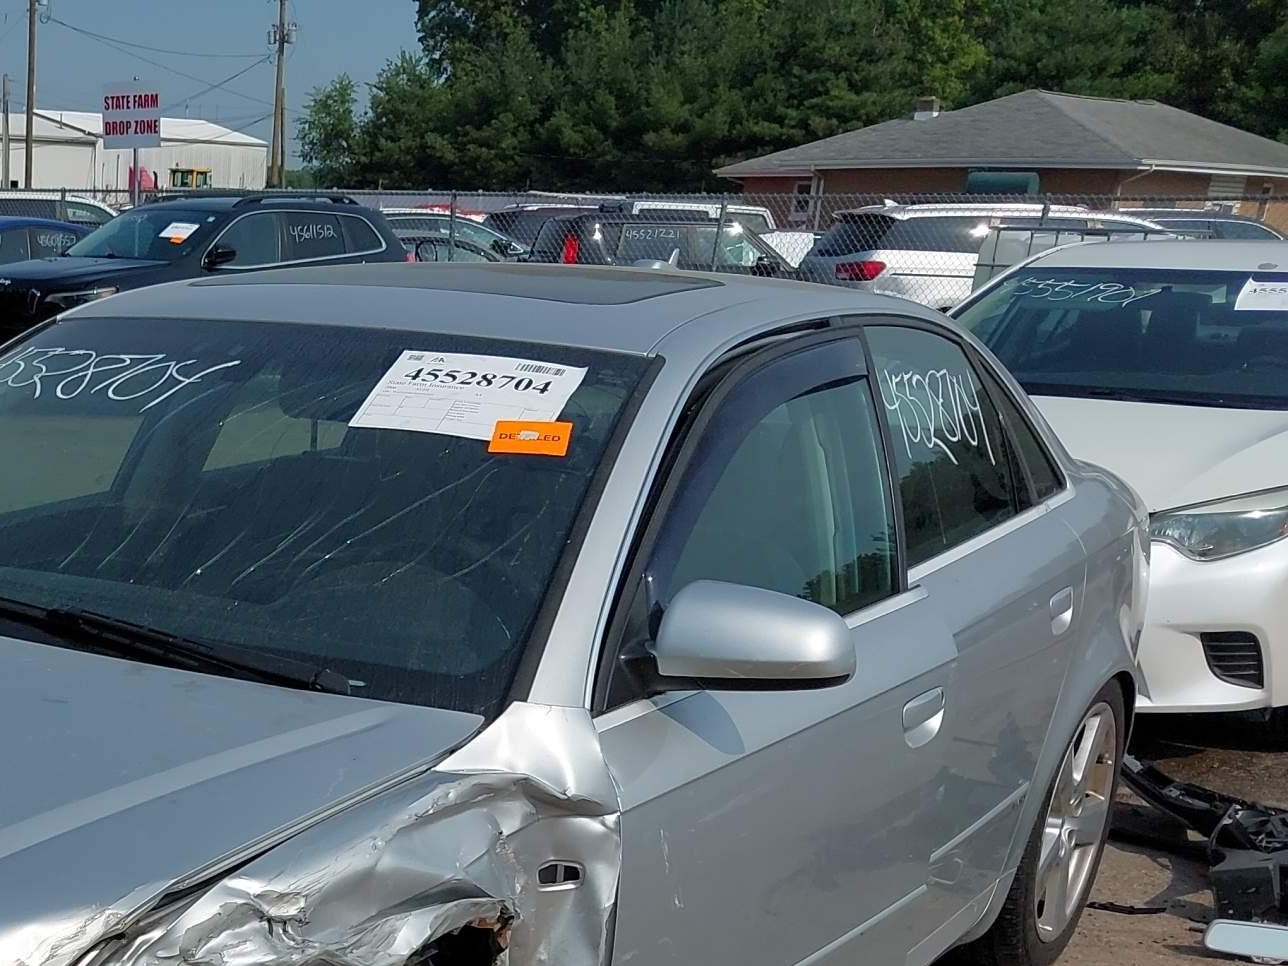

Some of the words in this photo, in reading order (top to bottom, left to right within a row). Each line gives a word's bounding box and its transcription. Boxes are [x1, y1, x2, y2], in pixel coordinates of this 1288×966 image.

[104, 95, 131, 111] STATE
[133, 93, 159, 109] FARM
[104, 120, 132, 136] DROP
[134, 119, 159, 135] ZONE
[289, 224, 338, 244] 45611512
[403, 367, 553, 395] 45528704
